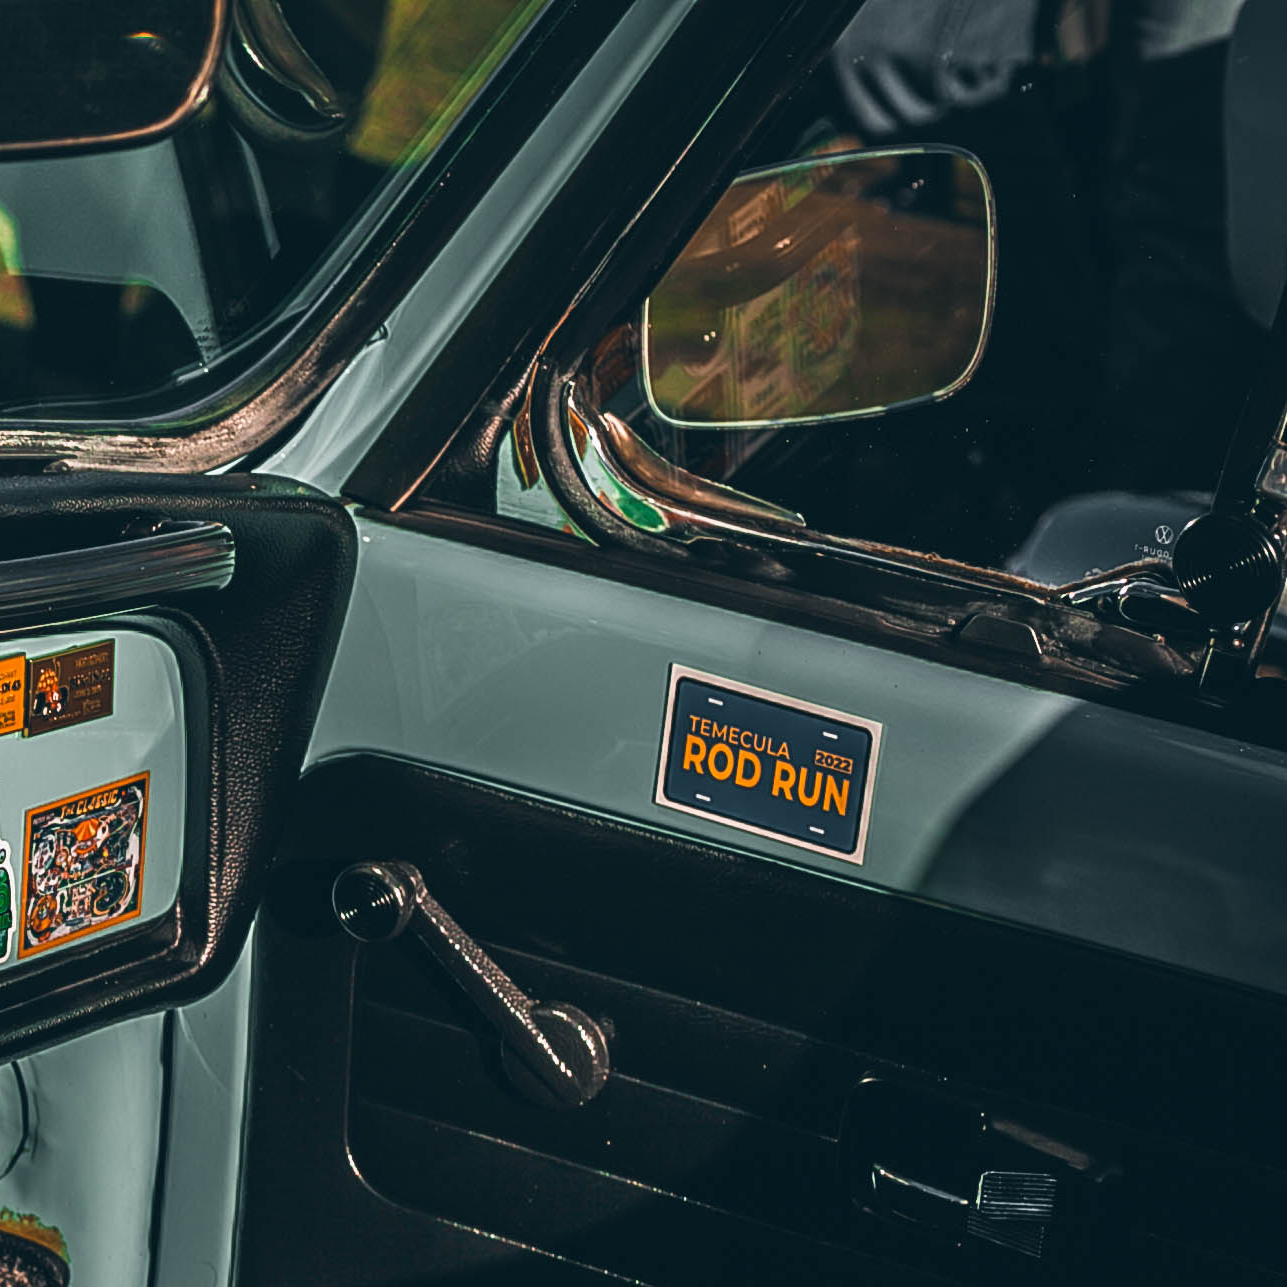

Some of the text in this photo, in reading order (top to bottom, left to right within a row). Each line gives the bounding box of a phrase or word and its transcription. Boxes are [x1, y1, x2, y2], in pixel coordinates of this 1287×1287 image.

[689, 715, 790, 760] TEMECULA
[683, 734, 850, 816] ROD RUN
[815, 750, 853, 774] 2022
[76, 790, 118, 814] CLASSIC
